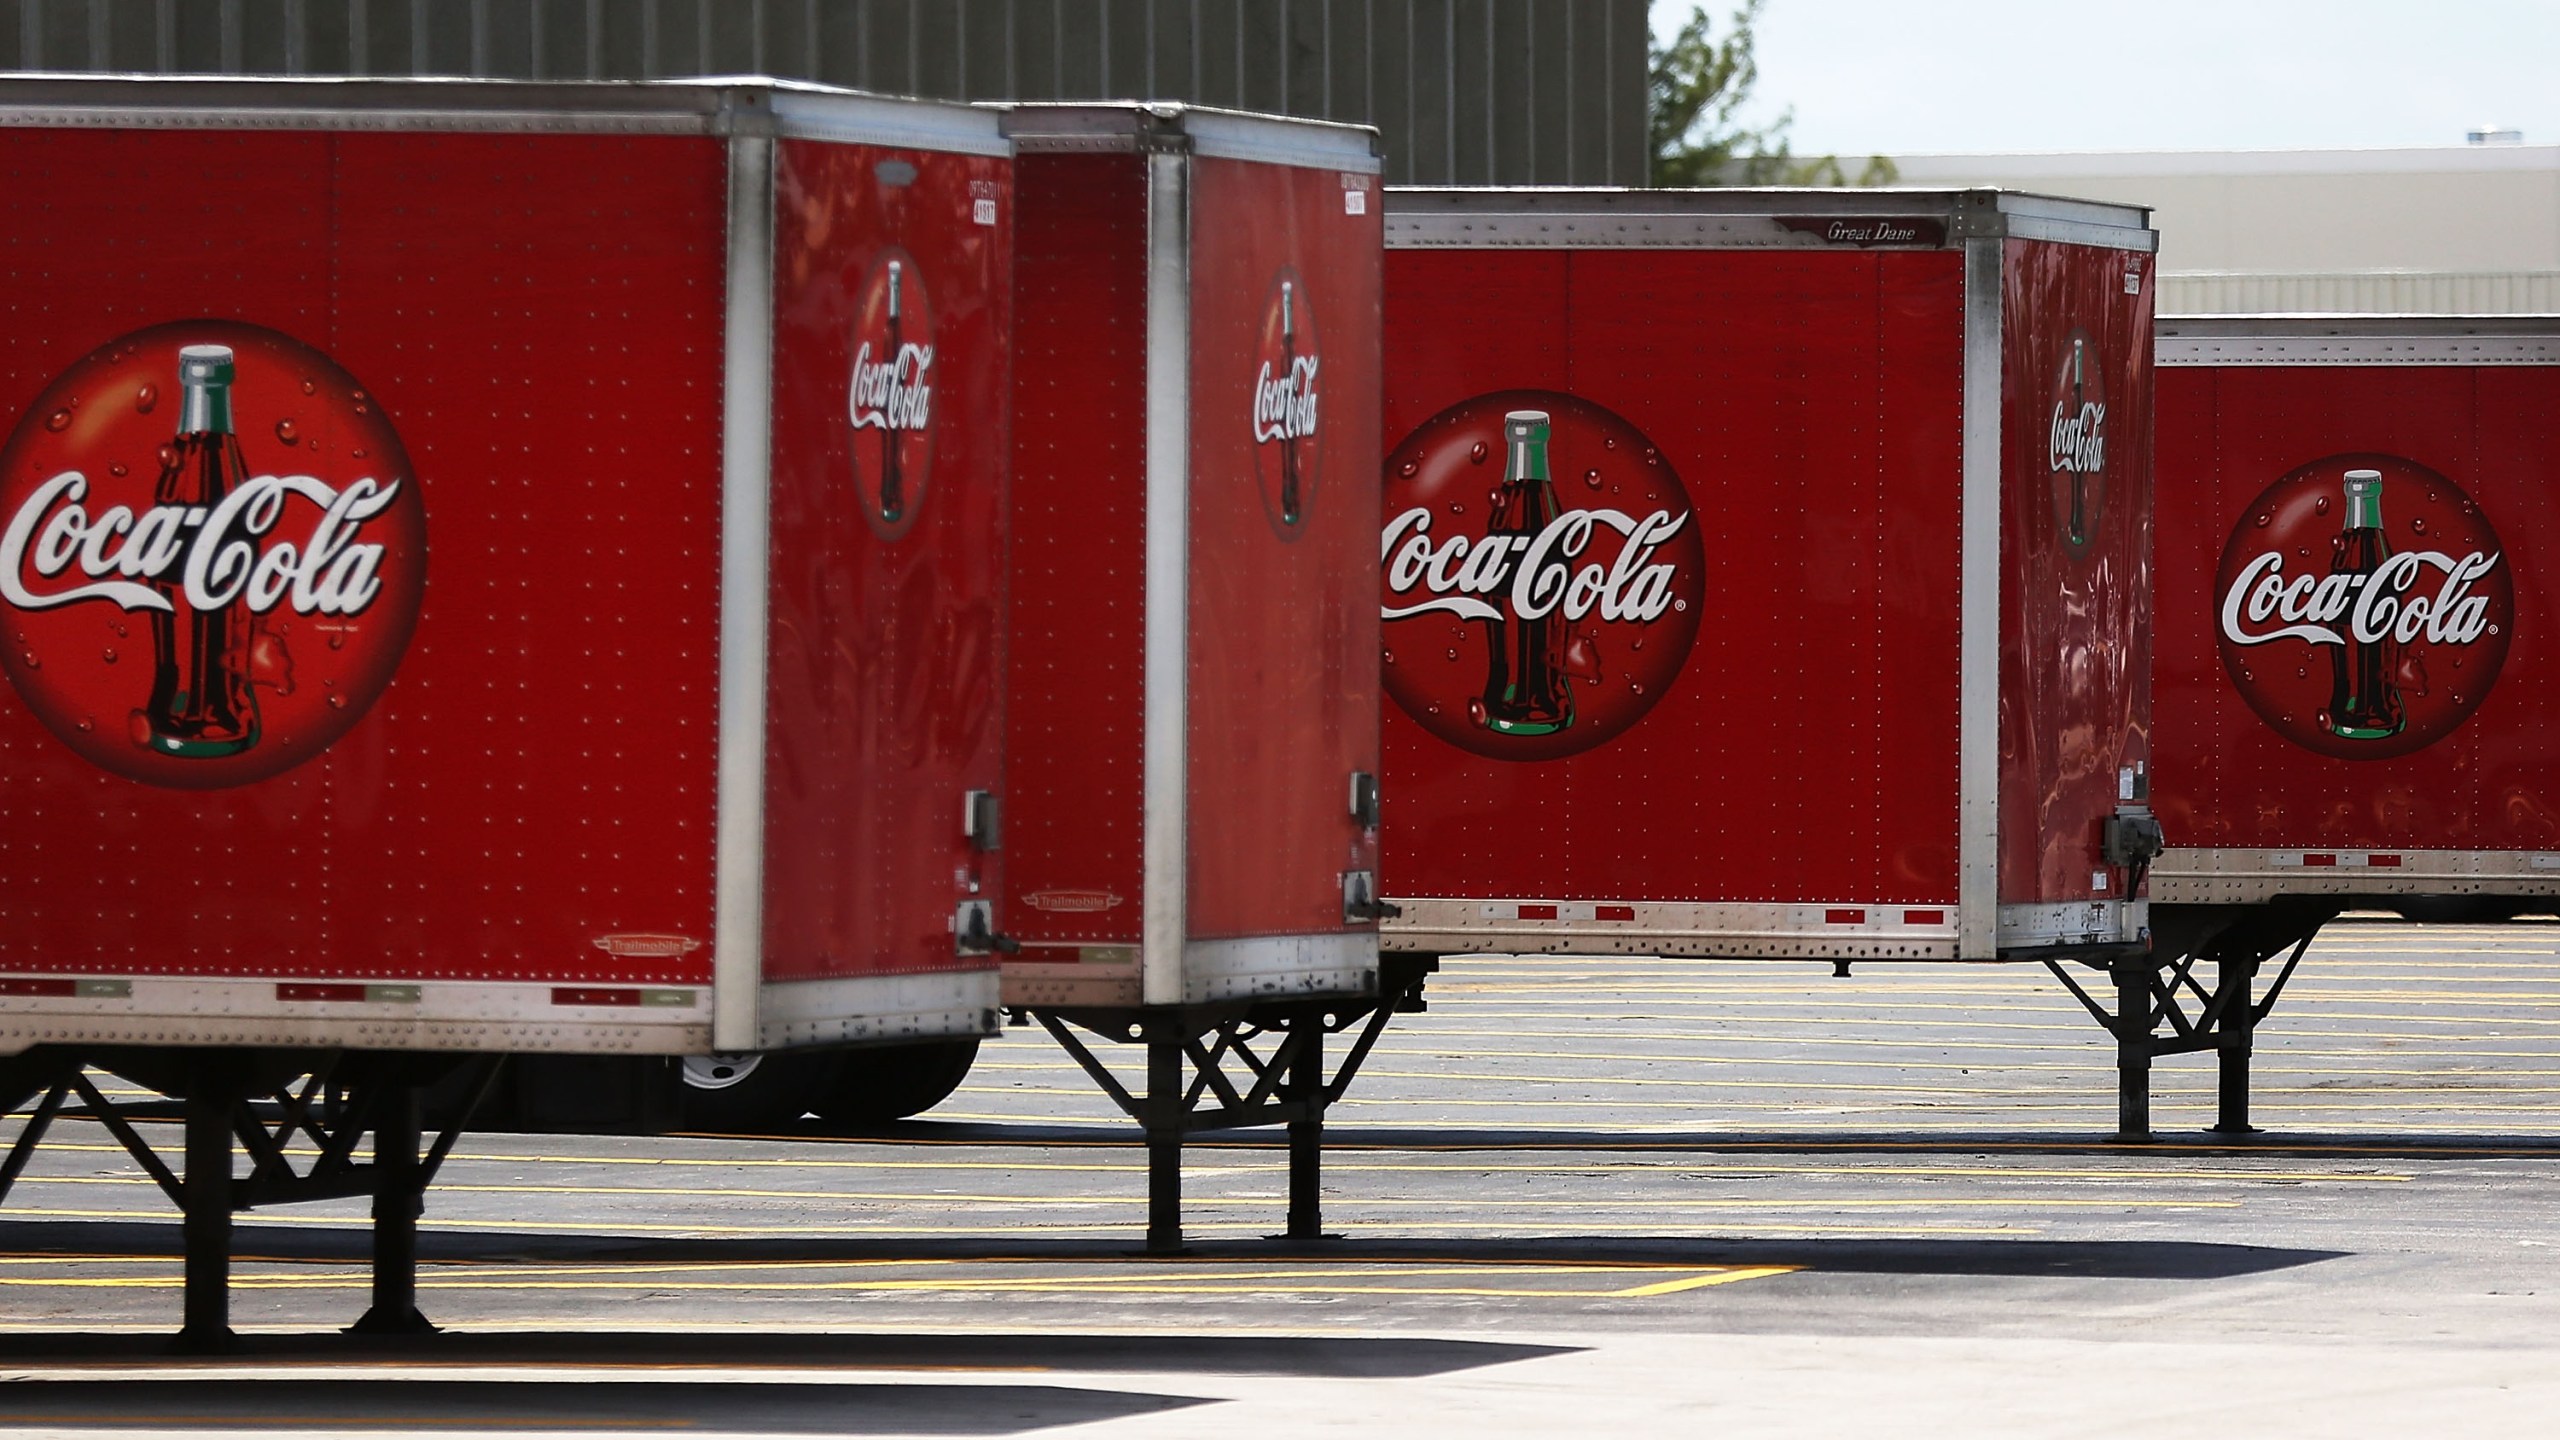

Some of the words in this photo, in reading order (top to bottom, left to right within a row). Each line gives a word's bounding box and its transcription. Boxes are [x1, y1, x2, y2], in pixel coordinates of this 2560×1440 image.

[1828, 221, 1872, 240] Great
[1873, 222, 1916, 240] Dane
[849, 341, 933, 430] Coca-Cola
[1254, 354, 1318, 443] Coca-Cola
[2050, 400, 2105, 472] Coca-Cola
[0, 470, 401, 613] Coca-Cola
[1381, 507, 1688, 621] Coca-Cola
[2222, 551, 2500, 645] Coca-Cola
[615, 940, 681, 953] Trailmobile
[1042, 896, 1104, 909] Trailmobile
